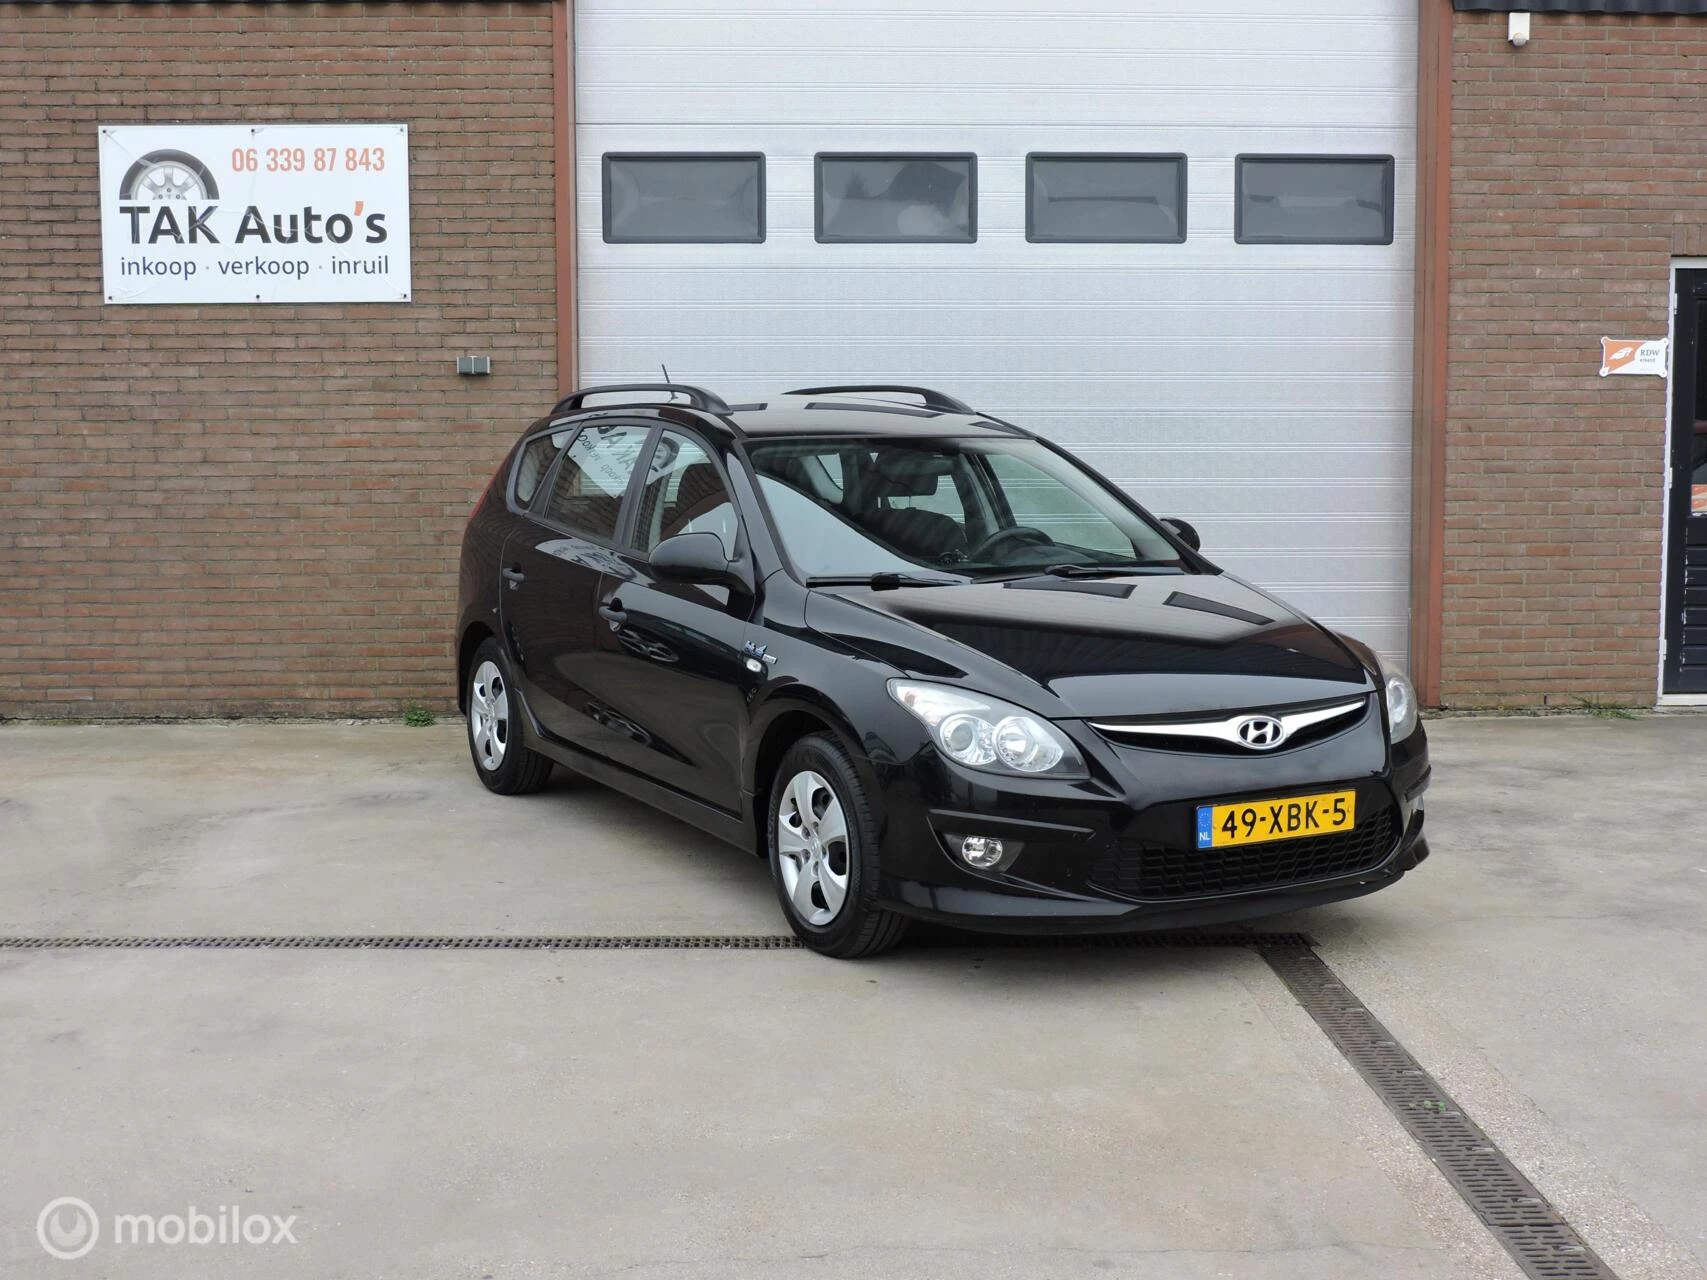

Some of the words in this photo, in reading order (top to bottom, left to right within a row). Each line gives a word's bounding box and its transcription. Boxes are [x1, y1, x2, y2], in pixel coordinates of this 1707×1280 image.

[231, 148, 258, 172] 06
[266, 147, 305, 172] 339
[313, 147, 337, 172] 87
[345, 147, 385, 172] 843
[119, 205, 220, 244] TAK
[234, 200, 388, 244] Auto's
[120, 256, 197, 280] inkoop
[217, 256, 309, 280] verkoop
[331, 255, 389, 275] inruil
[1640, 349, 1660, 357] RDW
[1221, 797, 1347, 839] 49-XBK-5
[1199, 832, 1211, 841] NL
